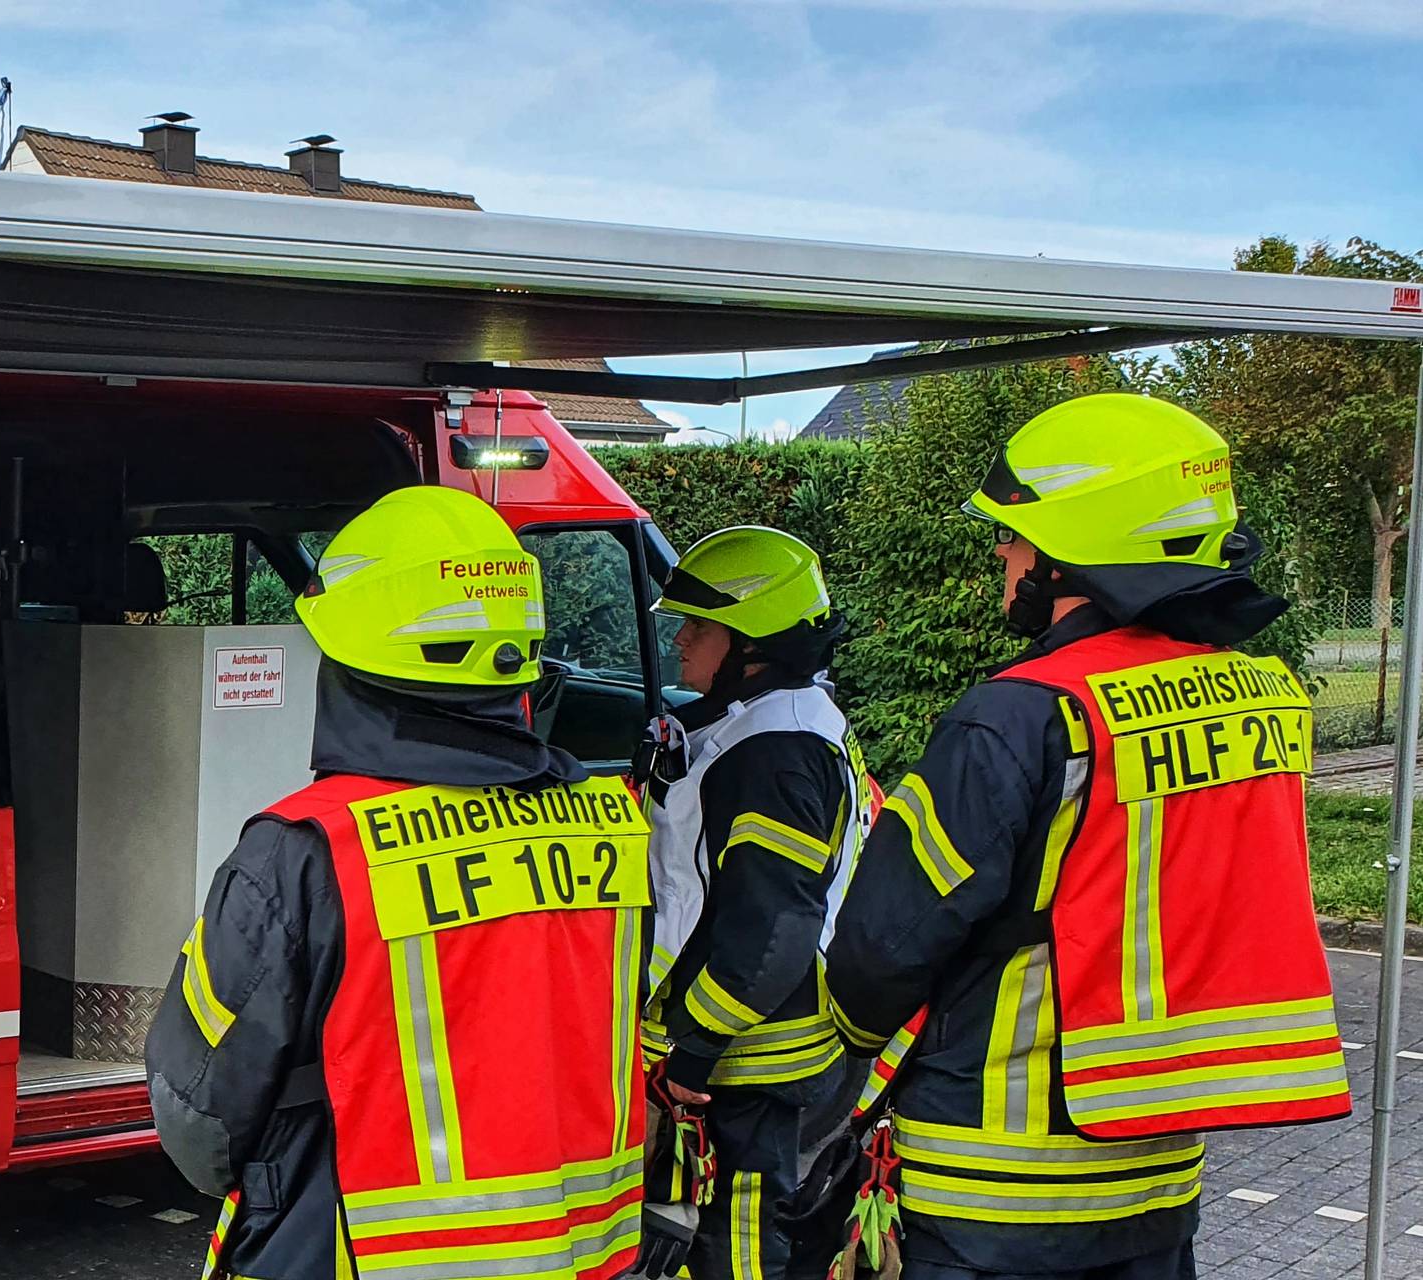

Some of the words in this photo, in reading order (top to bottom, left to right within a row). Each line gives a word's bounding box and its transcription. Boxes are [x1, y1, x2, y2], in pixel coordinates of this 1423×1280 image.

[440, 557, 534, 579] Feuerwehr
[463, 584, 528, 599] Vettweiss
[232, 653, 268, 665] Aufenthalt
[218, 671, 248, 683] während
[250, 671, 261, 682] der
[263, 670, 281, 681] Fahrt
[223, 688, 240, 700] nicht
[242, 687, 274, 702] gestattet!
[1099, 659, 1300, 723] Einheitsführer
[1141, 722, 1230, 793] HLF
[416, 852, 493, 926] LF
[513, 841, 620, 906] 10-2
